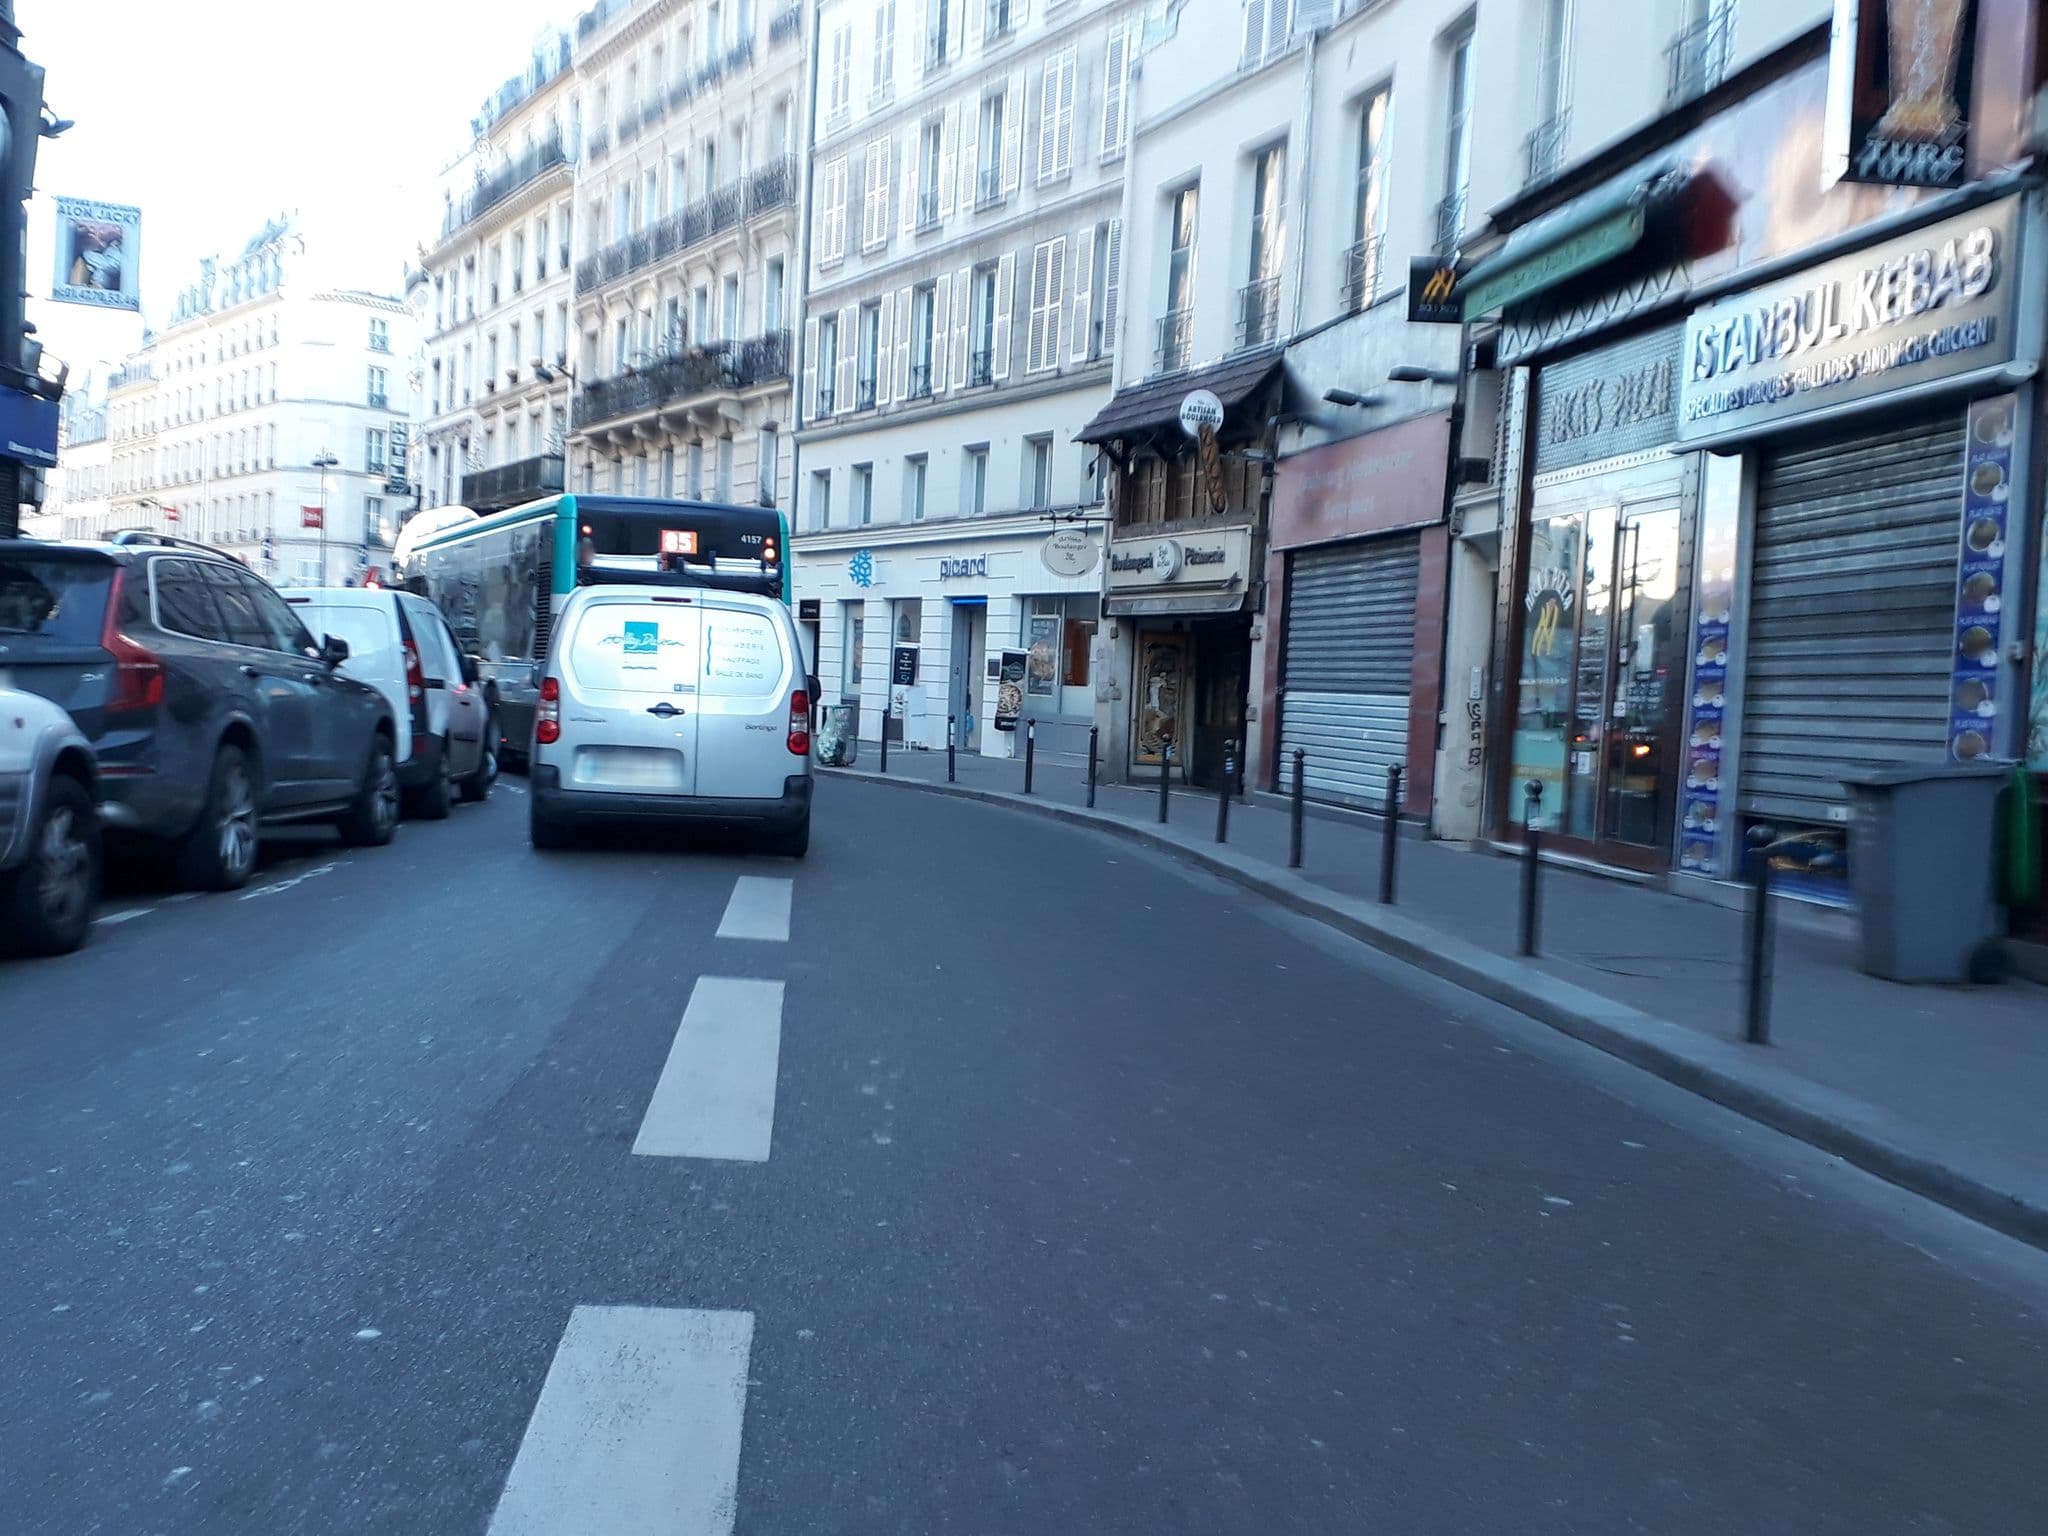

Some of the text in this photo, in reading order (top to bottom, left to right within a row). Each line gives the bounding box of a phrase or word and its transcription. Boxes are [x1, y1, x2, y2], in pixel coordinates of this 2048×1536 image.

[1860, 139, 1964, 177] TURC
[1691, 227, 1994, 383] ISTANBUL KEBAB
[664, 532, 692, 552] 85
[740, 534, 762, 544] 4157
[940, 552, 987, 580] picard
